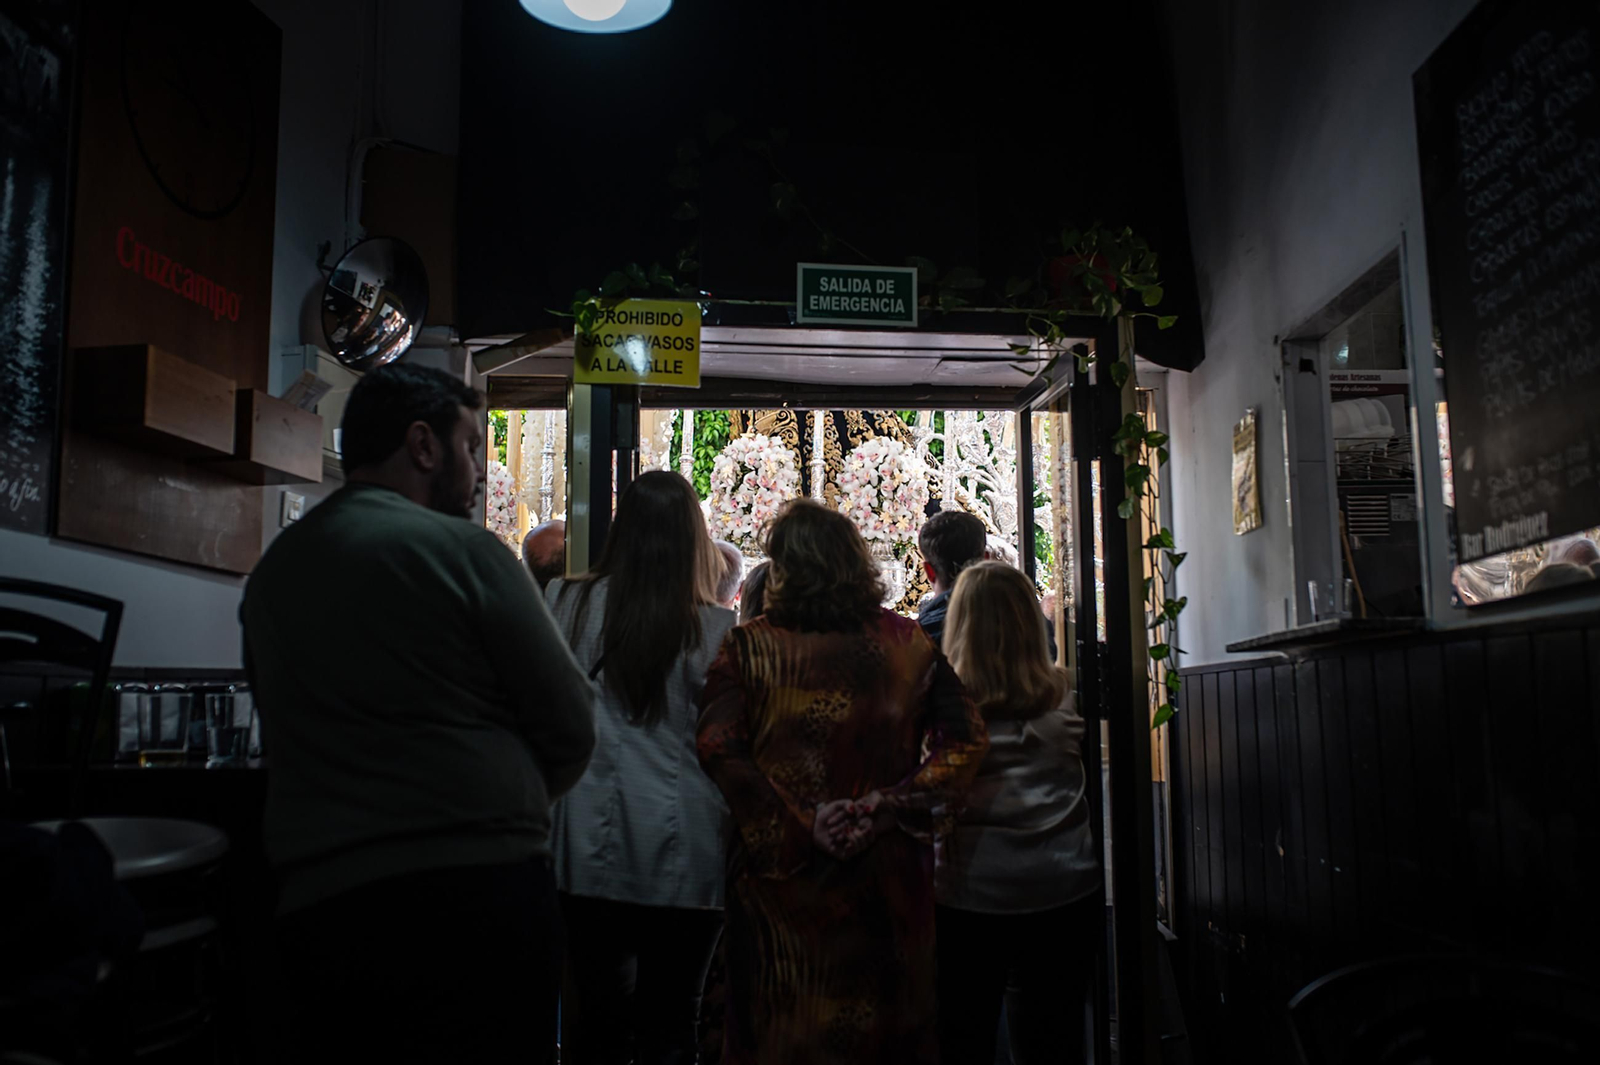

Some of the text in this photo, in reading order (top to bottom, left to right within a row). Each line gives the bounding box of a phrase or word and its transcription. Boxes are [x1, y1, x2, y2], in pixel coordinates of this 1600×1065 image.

[117, 225, 240, 321] Cruzcampo
[818, 275, 895, 295] SALIDA DE
[809, 294, 905, 314] EMERGENCIA
[595, 310, 684, 327] PROHIBIDO
[591, 357, 602, 372] A
[606, 358, 627, 373] LA
